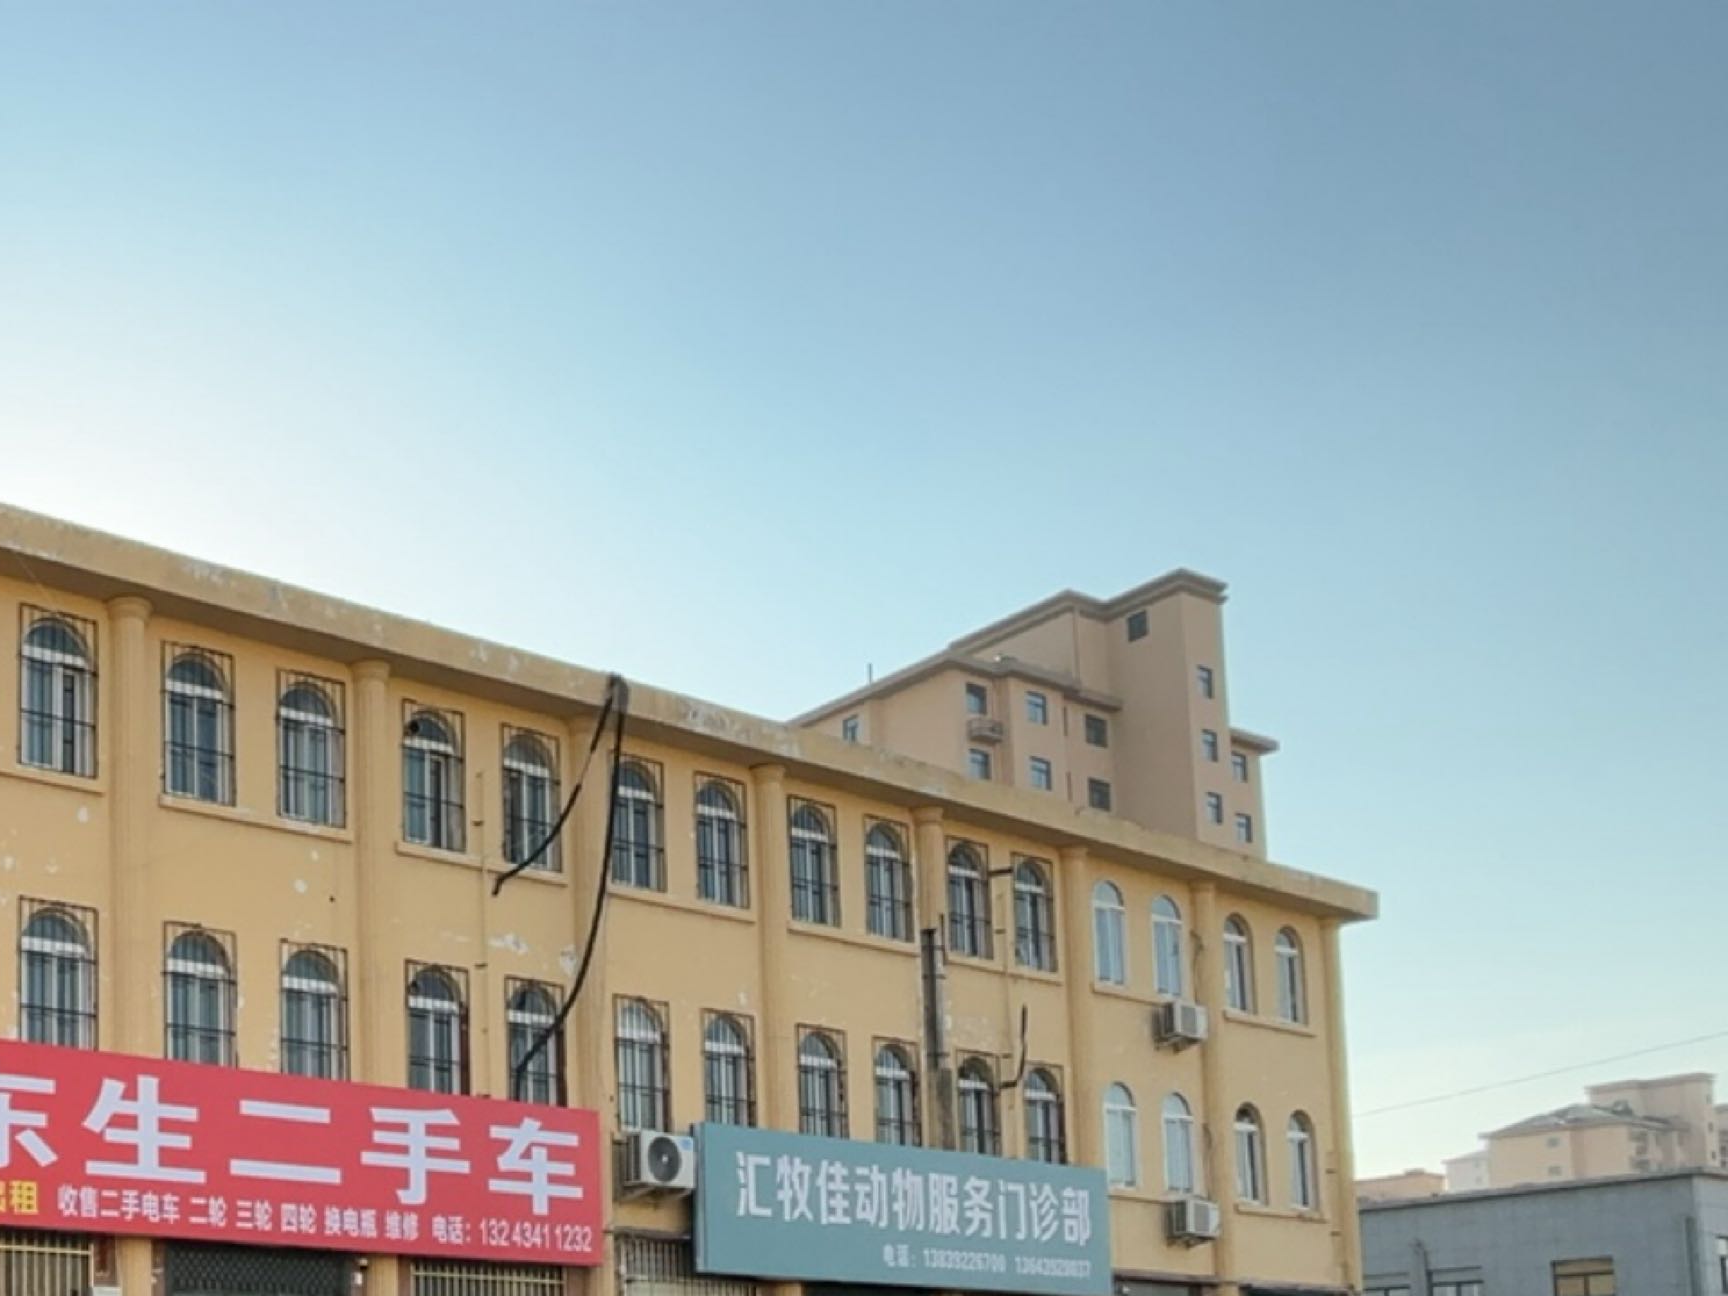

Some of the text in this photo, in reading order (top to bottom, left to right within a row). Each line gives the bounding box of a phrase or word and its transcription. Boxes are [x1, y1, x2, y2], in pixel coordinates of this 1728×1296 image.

[57, 1184, 180, 1224] 收售二手电车
[189, 1195, 227, 1227] 二轮
[235, 1200, 272, 1231] 三轮
[280, 1203, 317, 1234] 四轮
[324, 1206, 377, 1239] 换电瓶
[384, 1210, 419, 1241] 维修
[735, 1151, 1092, 1247] 汇牧佳动物服务门诊部
